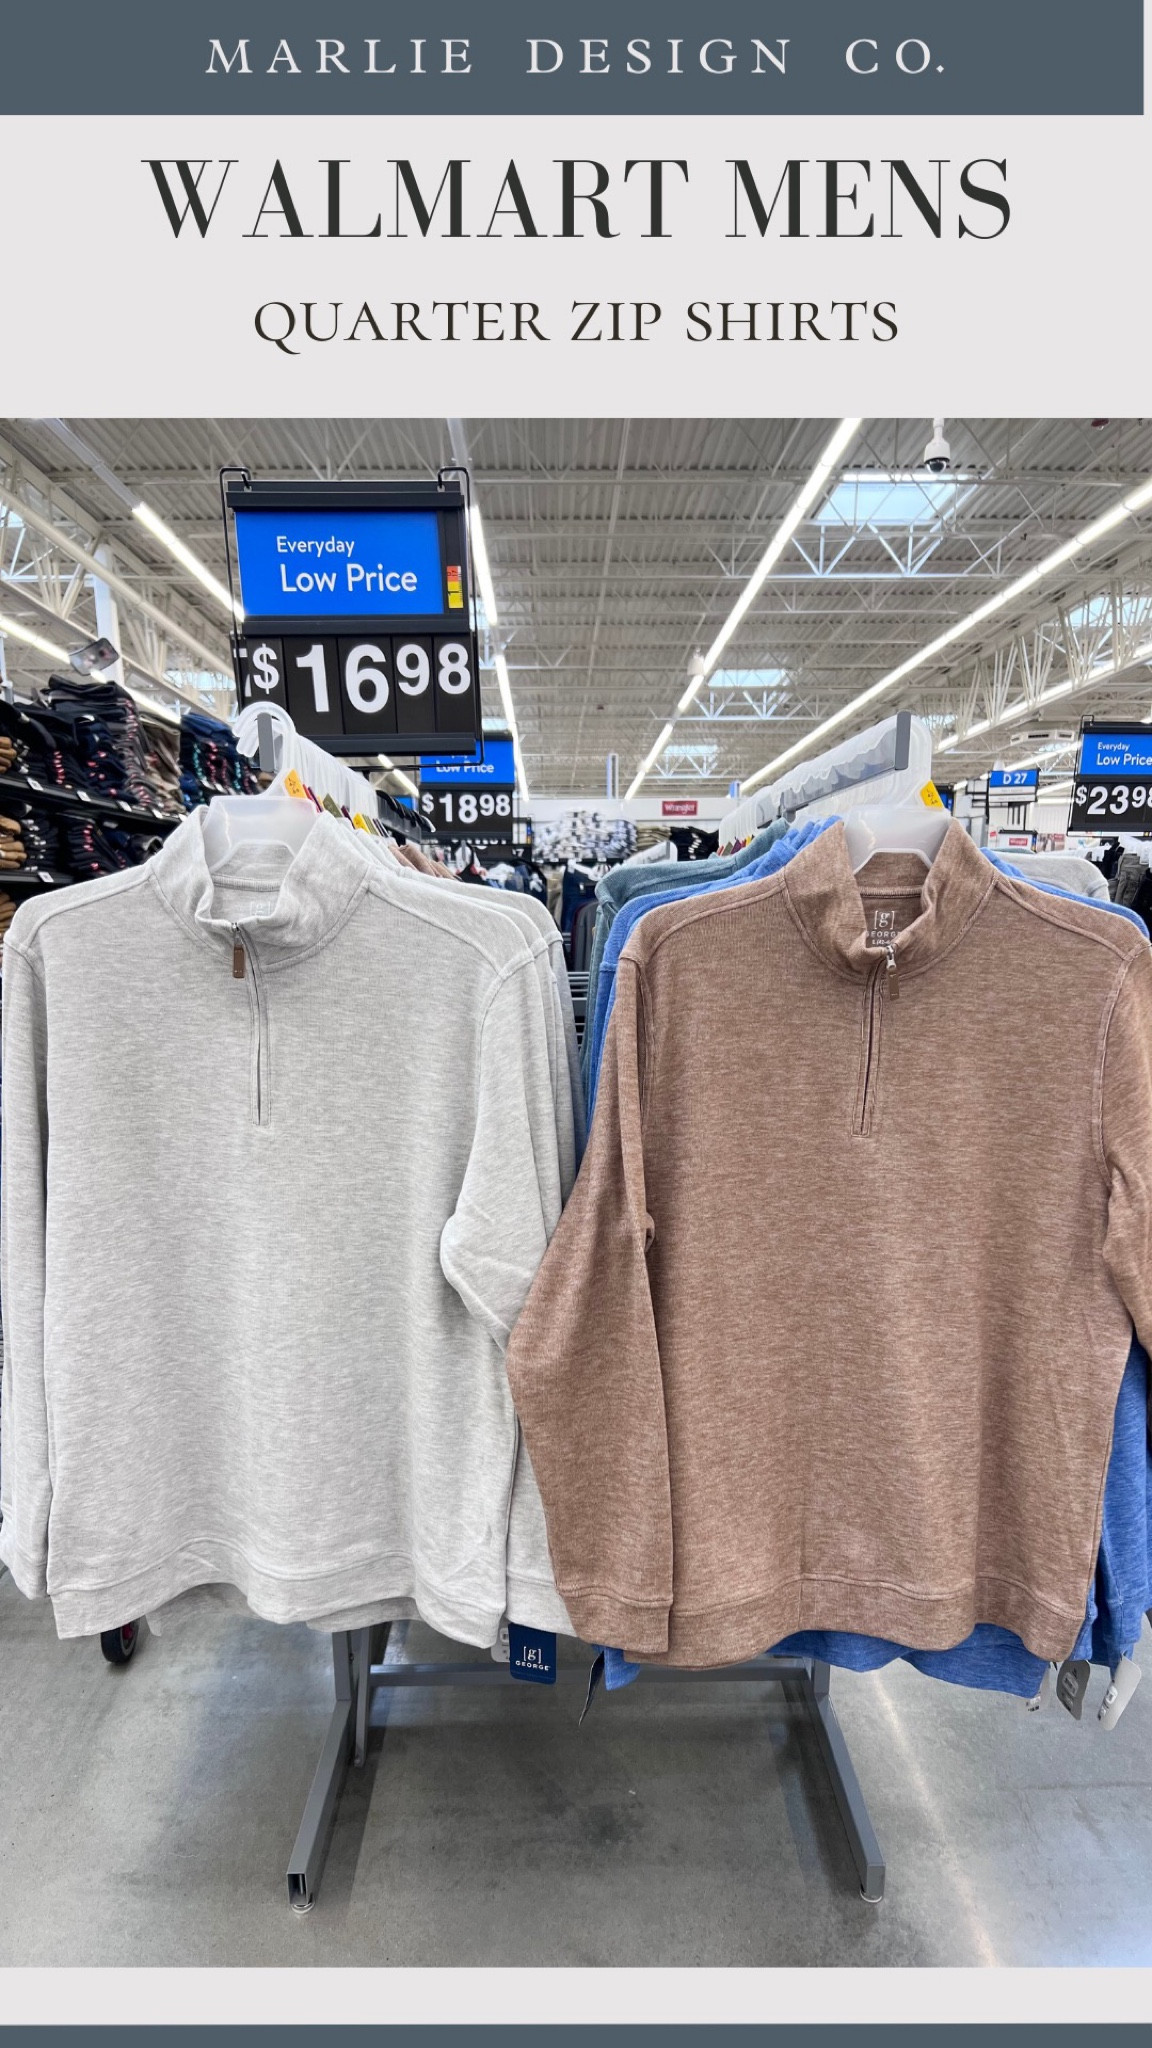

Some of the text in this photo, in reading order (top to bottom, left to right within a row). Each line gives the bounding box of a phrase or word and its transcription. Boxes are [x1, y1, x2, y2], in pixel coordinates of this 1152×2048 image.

[276, 535, 355, 558] Everyday
[280, 563, 418, 592] Low Price
[1097, 741, 1130, 752] Everyday
[1096, 753, 1152, 766] Low Price
[1002, 772, 1028, 785] D 27
[515, 1660, 550, 1671] GEORGE
